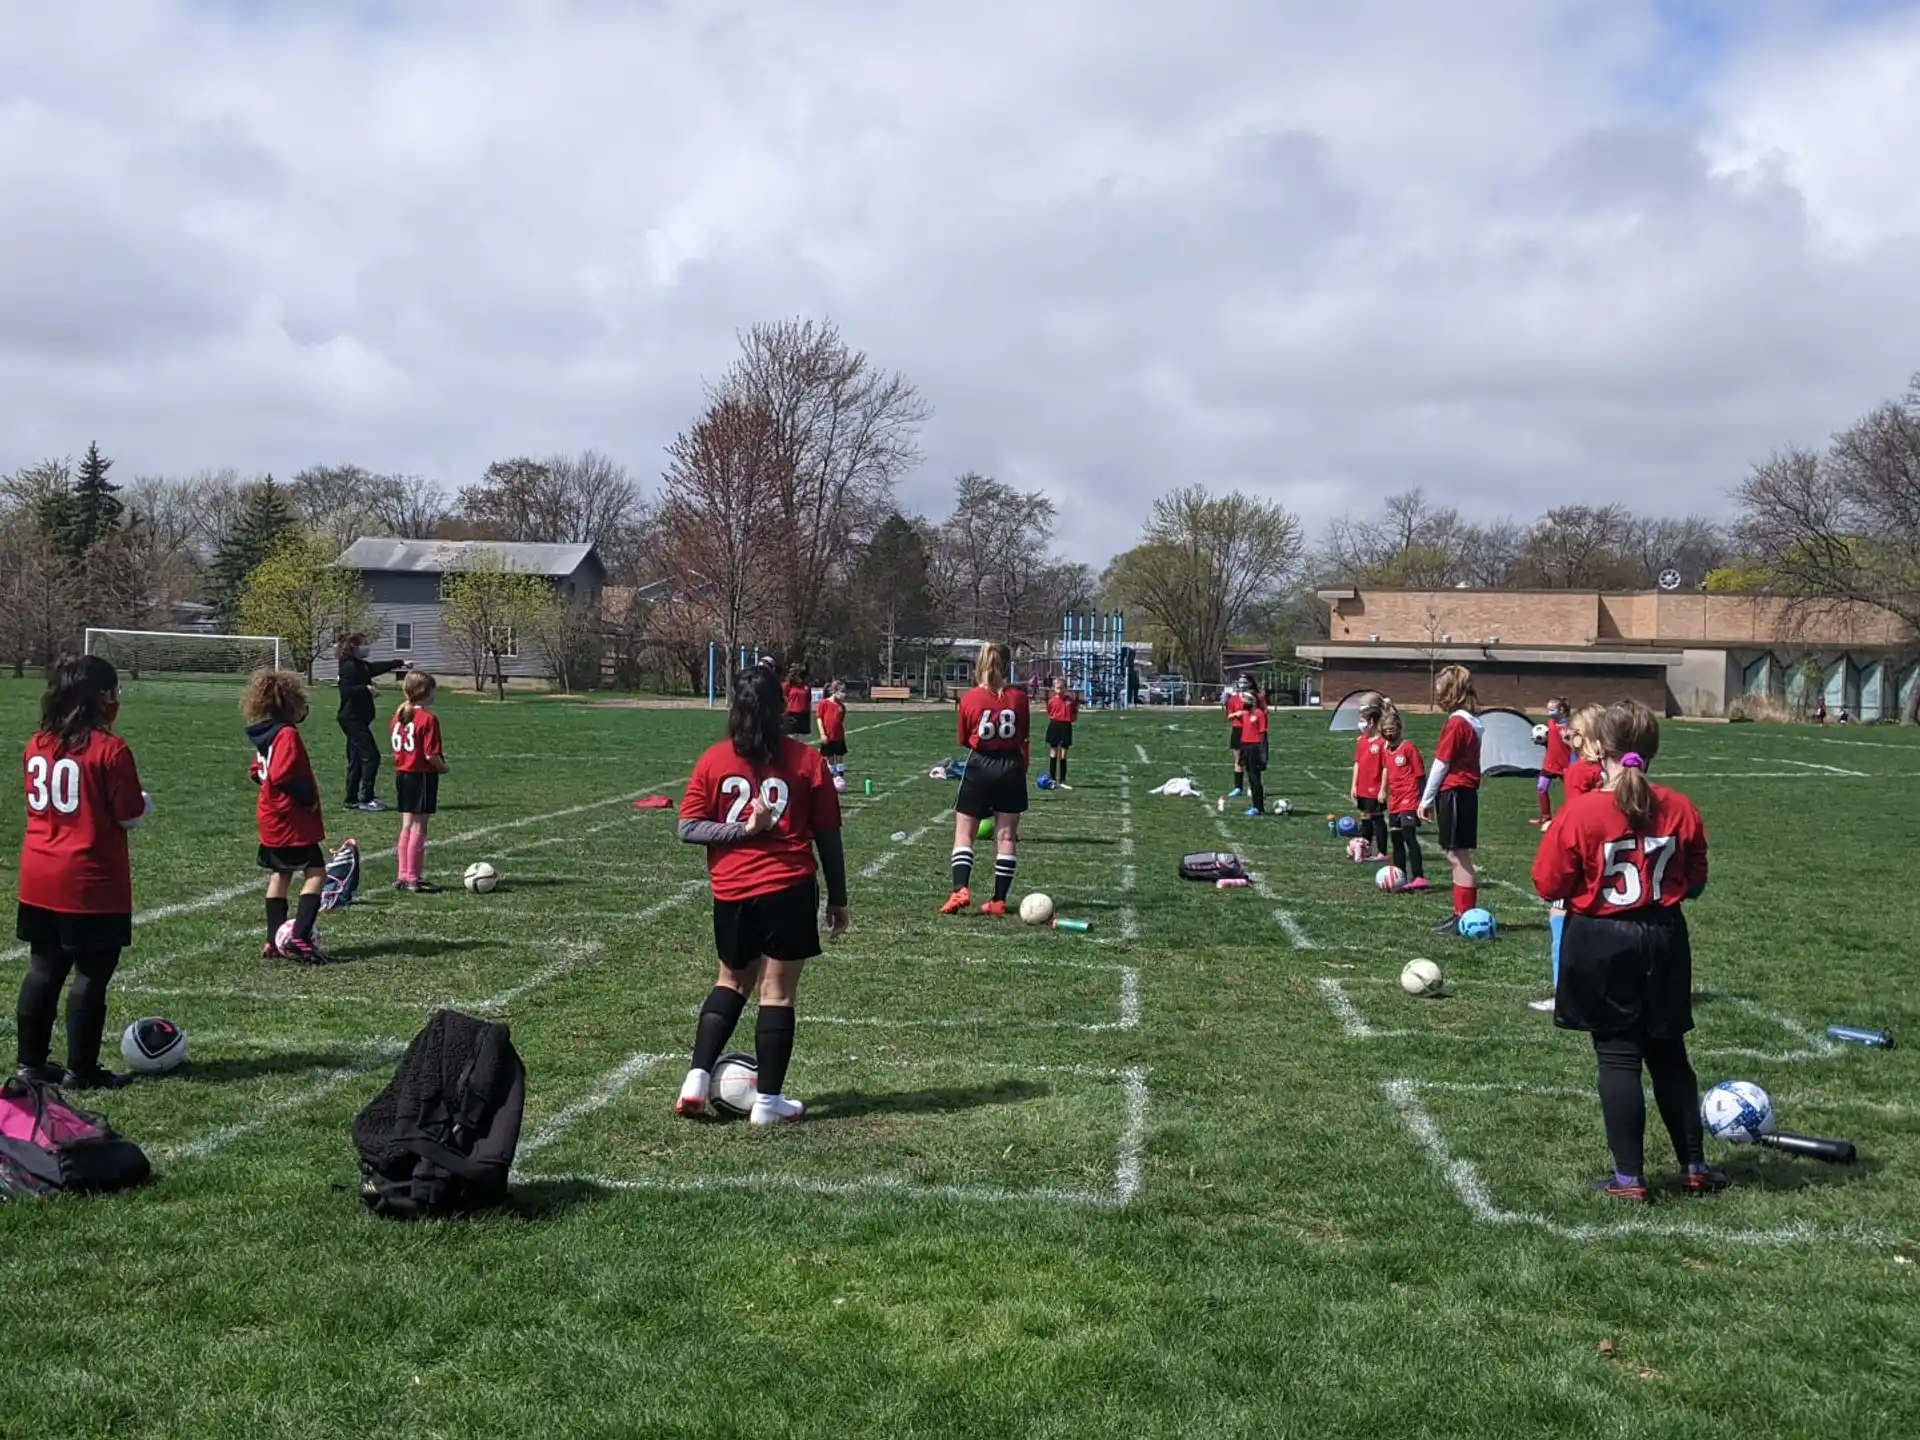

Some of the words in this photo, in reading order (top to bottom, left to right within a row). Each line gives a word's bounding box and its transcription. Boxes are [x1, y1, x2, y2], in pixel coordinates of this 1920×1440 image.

[391, 721, 416, 753] 63
[977, 709, 1016, 738] 68
[27, 755, 80, 814] 30
[721, 776, 789, 831] 29
[1602, 834, 1676, 906] 57
